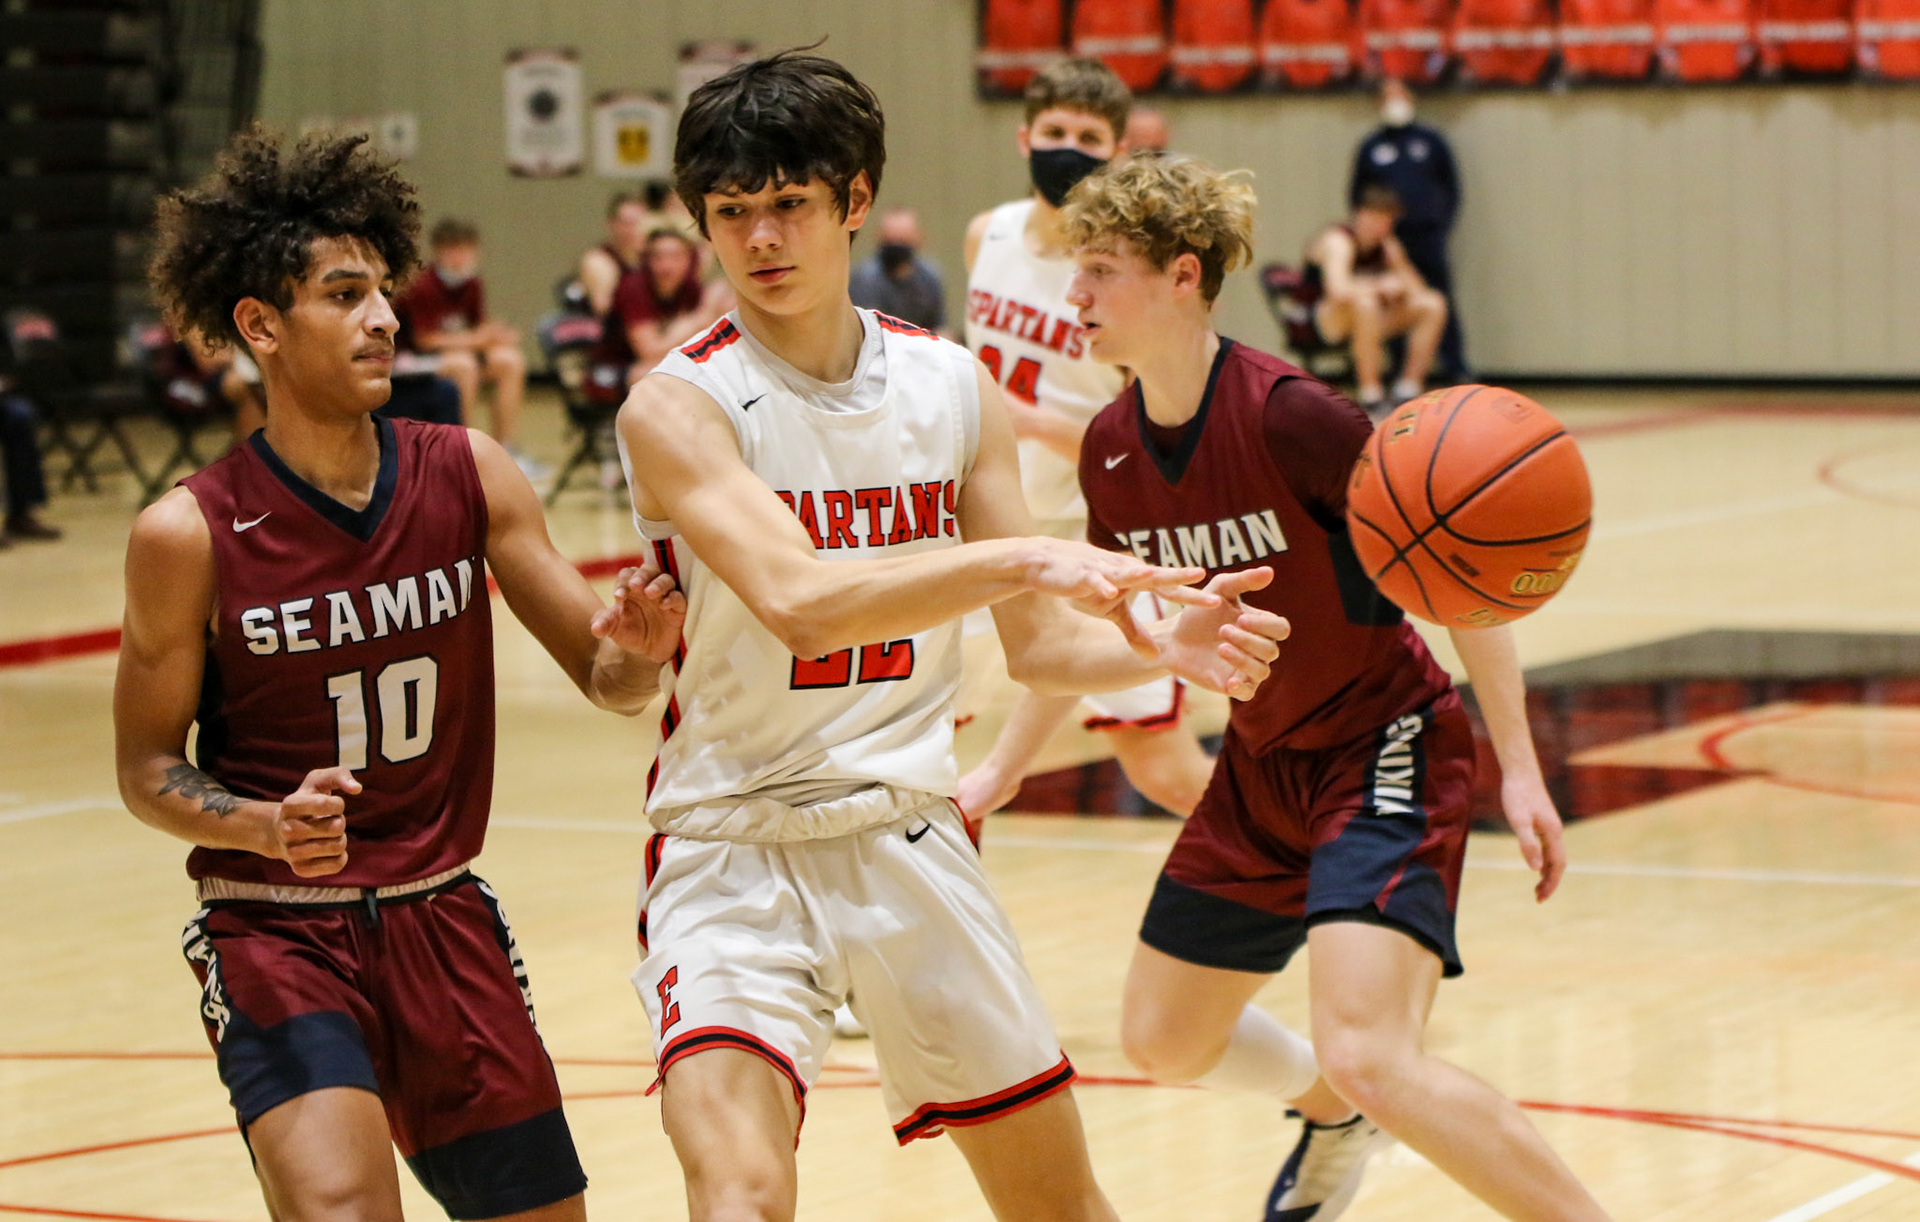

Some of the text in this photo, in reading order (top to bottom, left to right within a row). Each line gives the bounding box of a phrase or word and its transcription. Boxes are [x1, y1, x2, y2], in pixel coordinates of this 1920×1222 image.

[1115, 509, 1289, 569] EAMAN
[327, 655, 439, 771] 10
[1373, 714, 1423, 817] VIKING
[656, 965, 681, 1040] E
